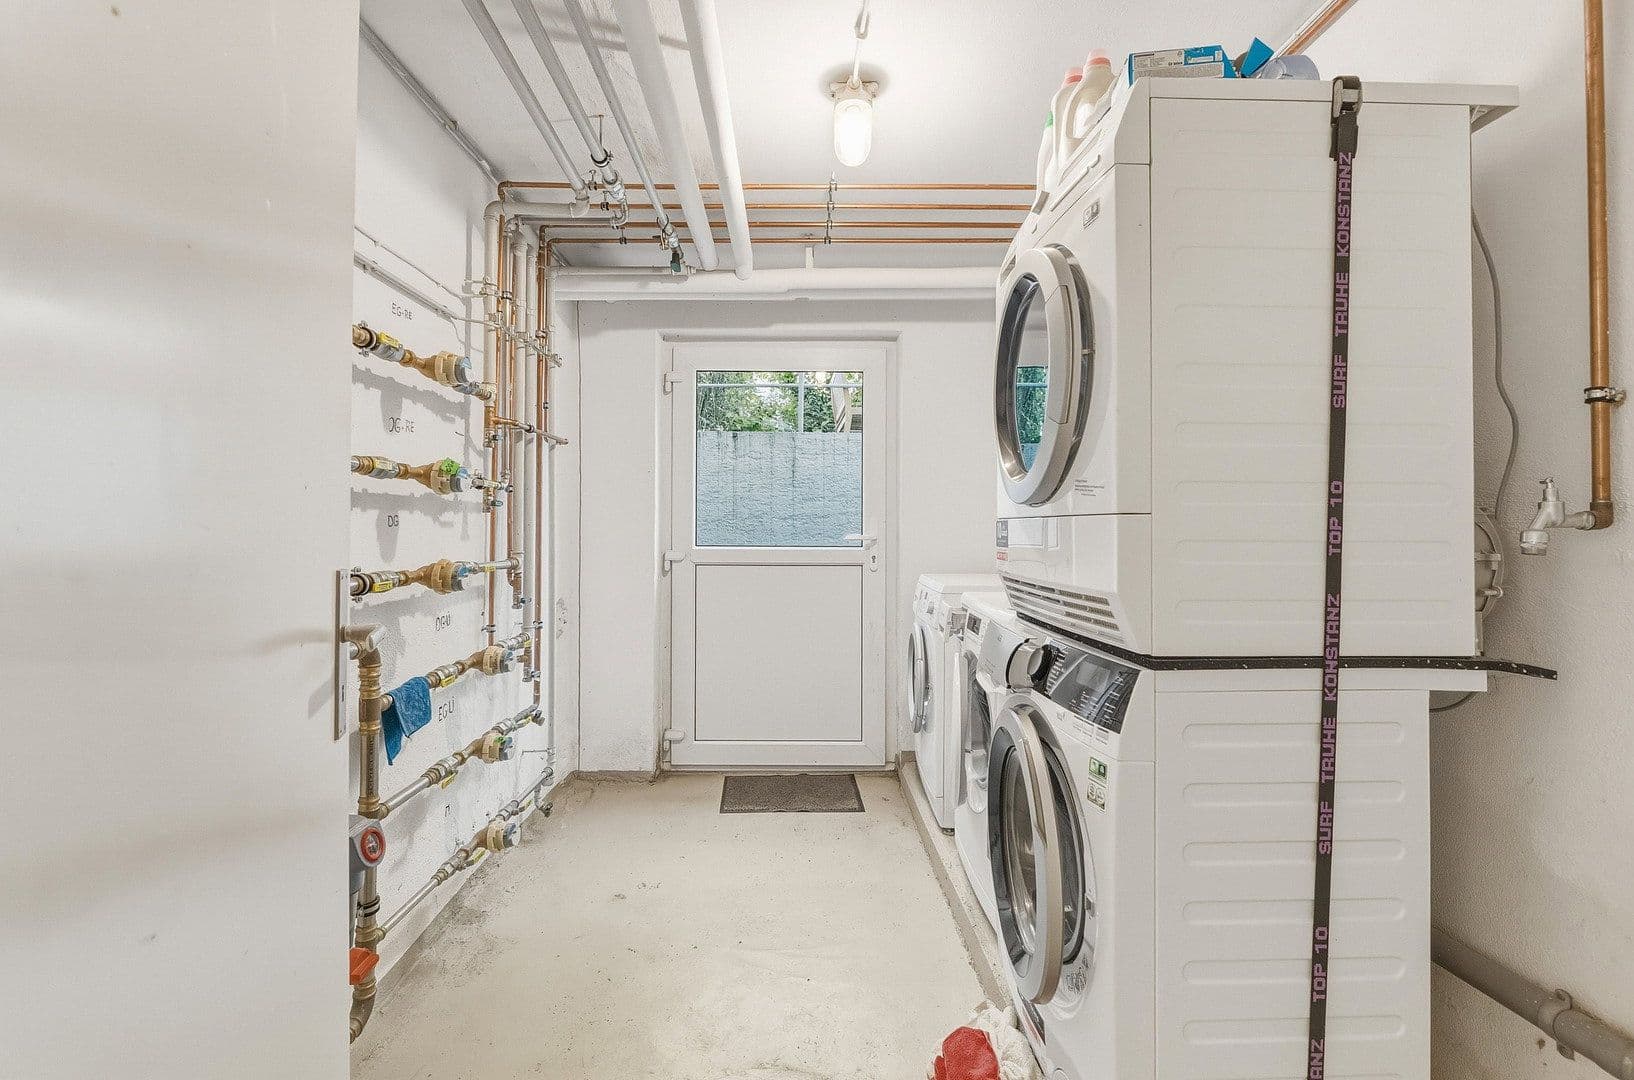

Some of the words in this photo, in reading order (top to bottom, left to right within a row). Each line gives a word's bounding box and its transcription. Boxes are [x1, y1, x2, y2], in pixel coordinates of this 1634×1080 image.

[1336, 152, 1352, 257] KONSTANZ
[1334, 272, 1349, 337] TRUHE
[1332, 354, 1347, 408] SURF
[1329, 480, 1343, 507] 10
[1328, 516, 1342, 556] TOP
[1324, 593, 1340, 702] KONSTANZ
[1321, 717, 1336, 784] TRUHE
[1318, 801, 1333, 855] SURF
[1314, 926, 1328, 954] 10
[1312, 963, 1327, 1002] TOP
